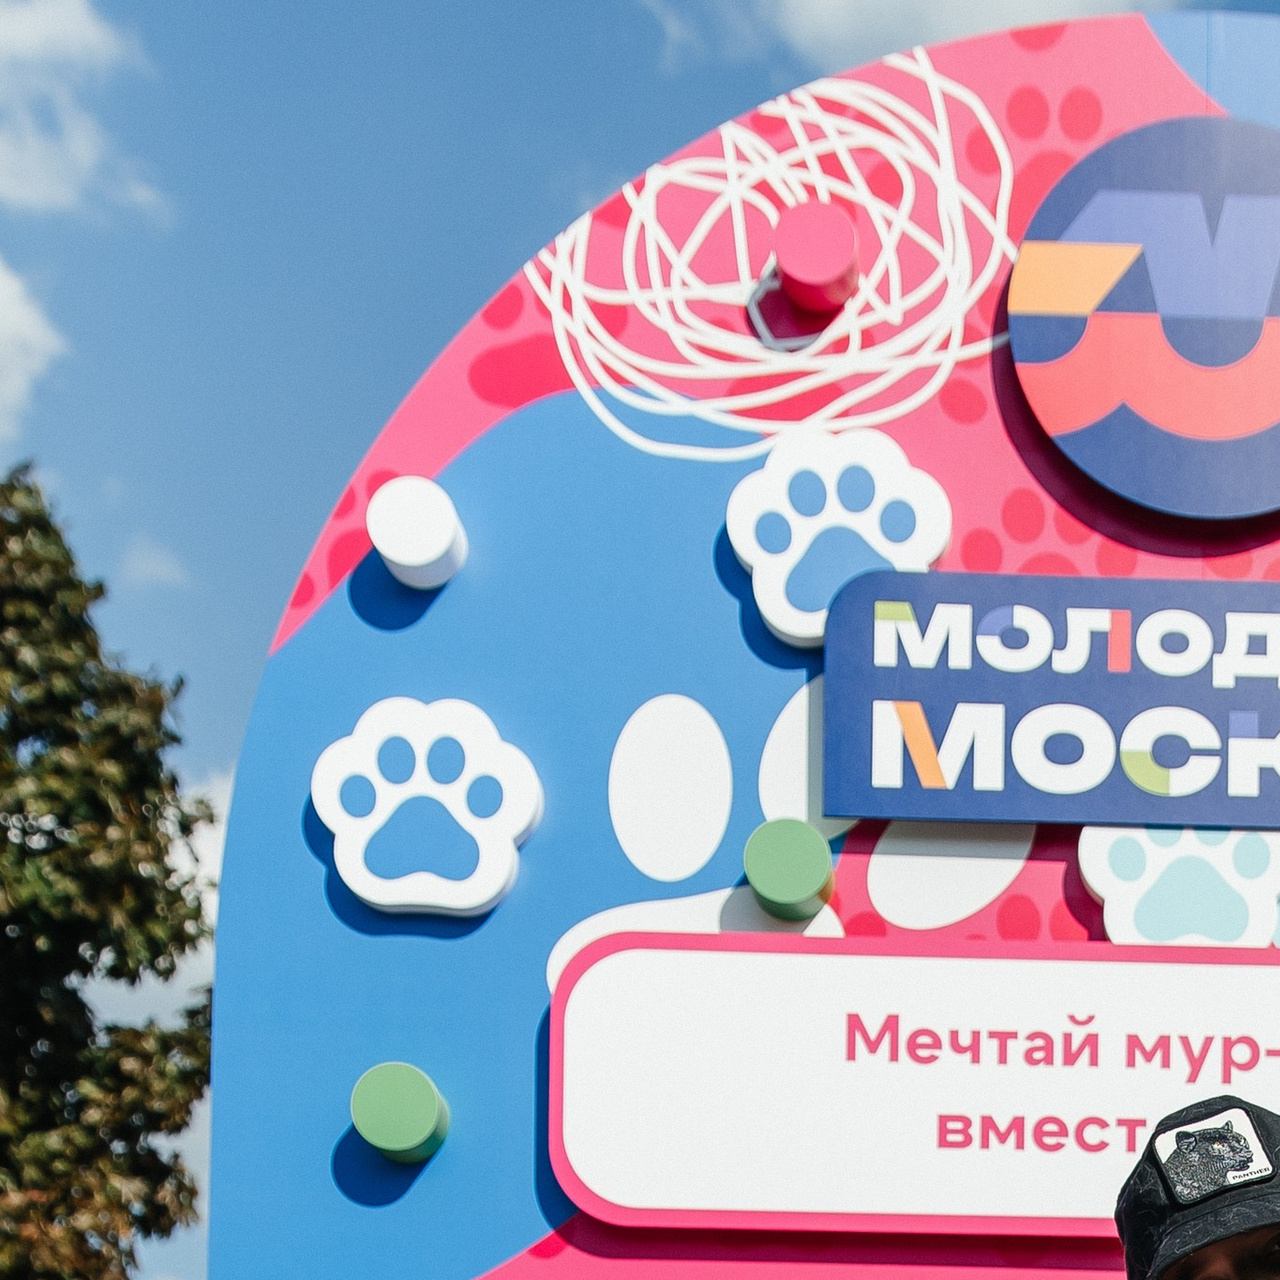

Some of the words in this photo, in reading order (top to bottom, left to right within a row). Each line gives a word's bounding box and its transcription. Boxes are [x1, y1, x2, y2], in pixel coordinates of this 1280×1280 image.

[844, 1012, 1100, 1068] Мечтай
[937, 1114, 1148, 1153] вмест
[1232, 1167, 1271, 1181] PANTHER
